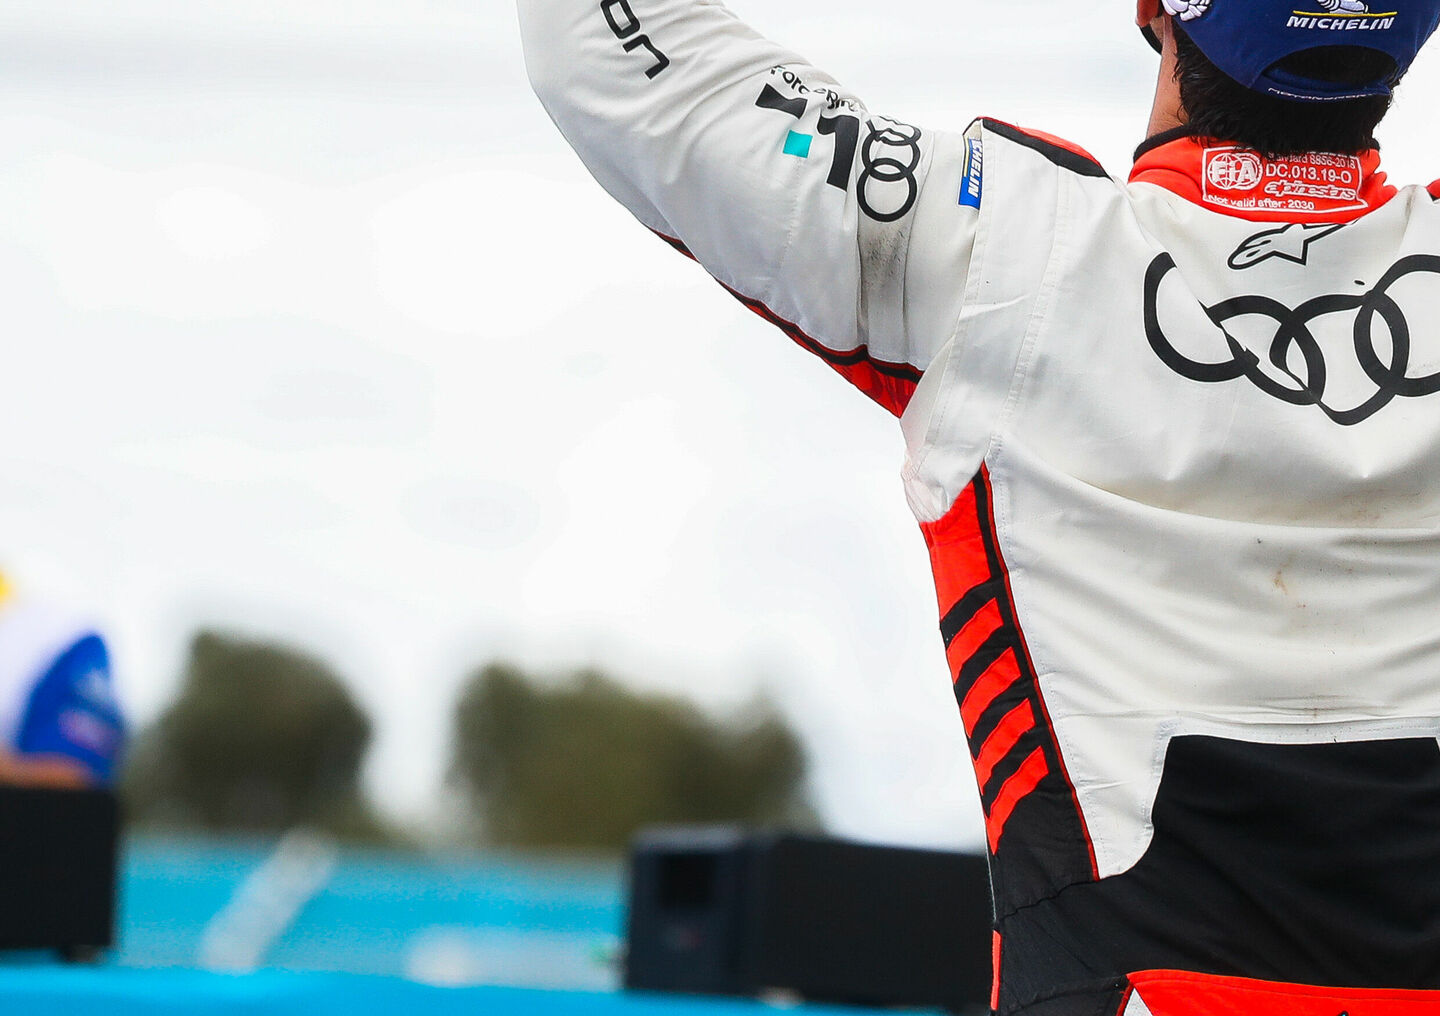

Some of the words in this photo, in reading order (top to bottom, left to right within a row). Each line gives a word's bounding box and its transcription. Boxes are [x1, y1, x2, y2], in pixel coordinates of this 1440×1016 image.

[1286, 15, 1395, 31] MICHELIN
[1207, 194, 1228, 205] Not
[1230, 197, 1256, 208] valid
[1257, 197, 1287, 209] after:
[1287, 199, 1315, 210] 2030
